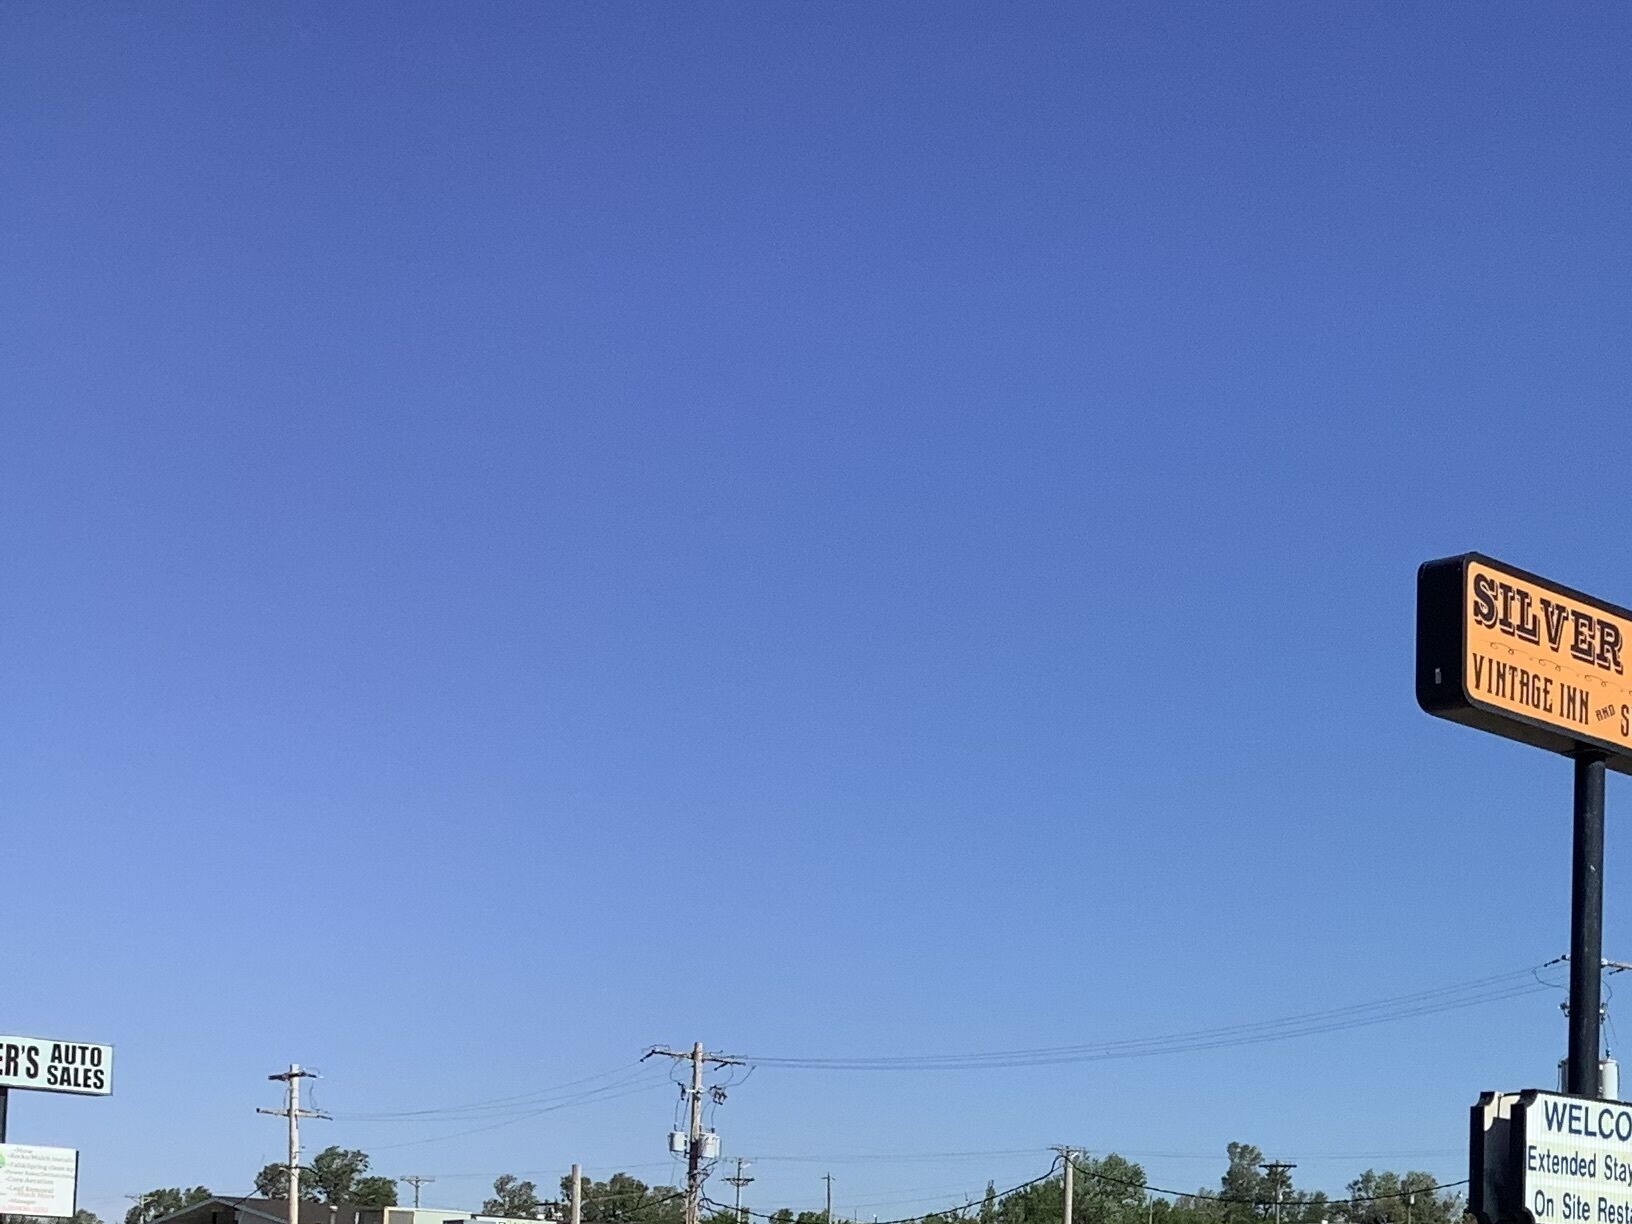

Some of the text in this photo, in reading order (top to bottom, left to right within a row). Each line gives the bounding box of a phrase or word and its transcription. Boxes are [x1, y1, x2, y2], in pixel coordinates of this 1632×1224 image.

[1472, 572, 1624, 675] SILVER
[1472, 652, 1554, 714] VINTAGE
[1559, 682, 1590, 726] INN
[1595, 704, 1616, 721] AND
[0, 1043, 102, 1079] R'S AUTO
[47, 1064, 105, 1090] SALES
[1527, 1145, 1597, 1178] Extended
[1534, 1189, 1554, 1217] On
[1562, 1192, 1591, 1221] Site
